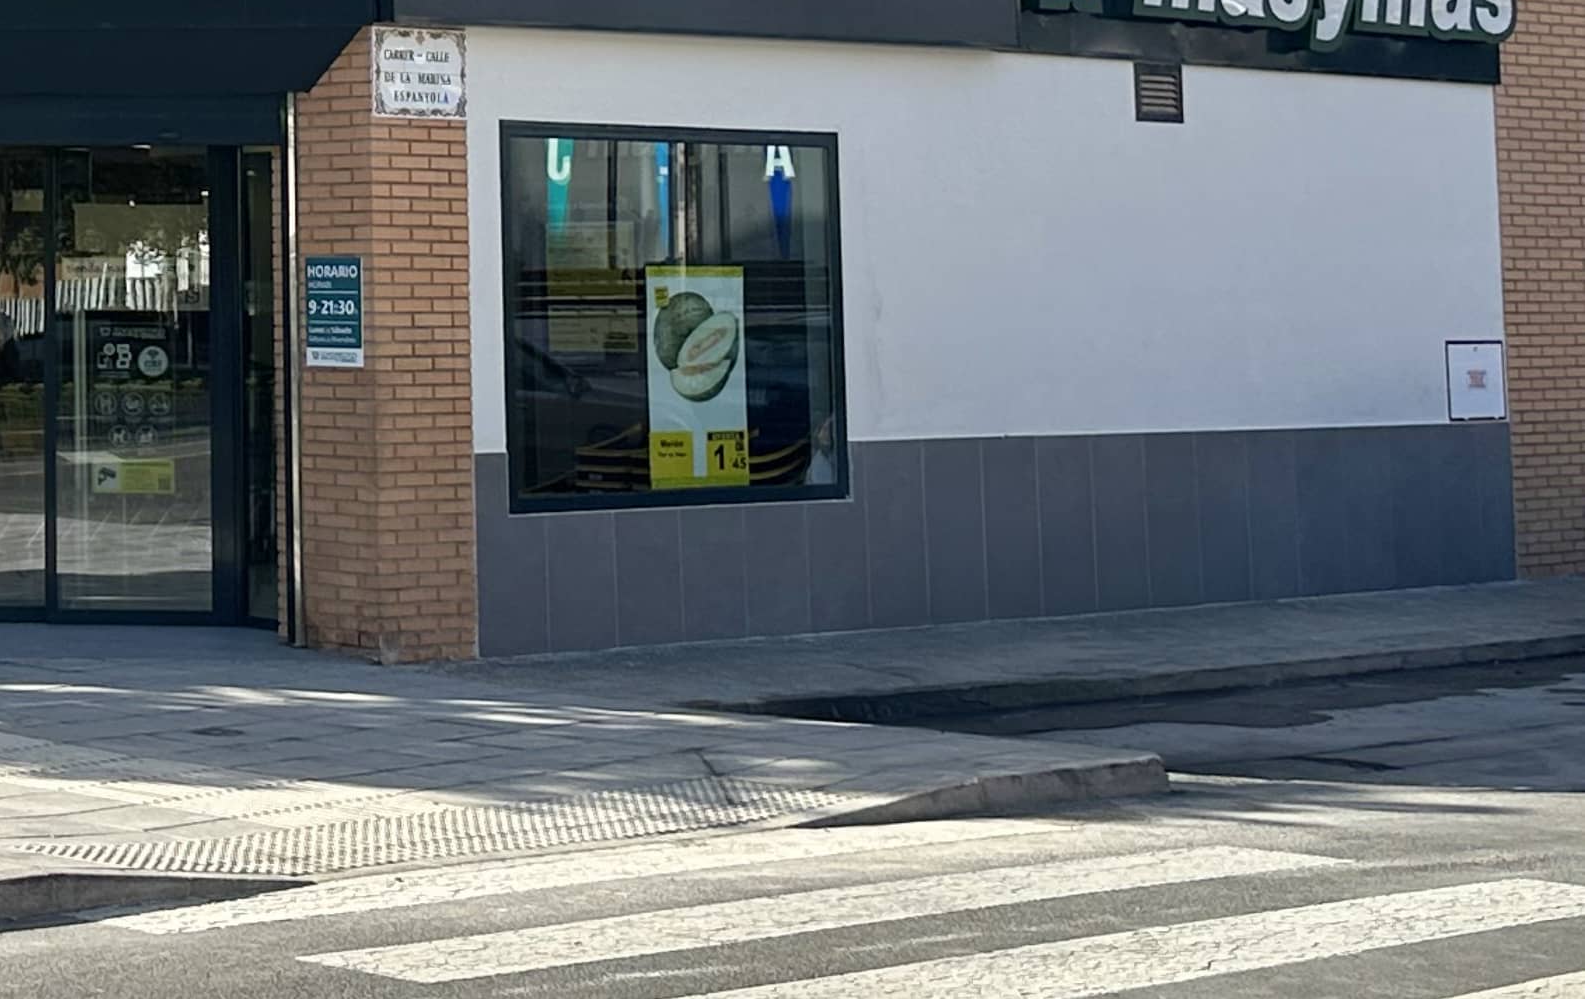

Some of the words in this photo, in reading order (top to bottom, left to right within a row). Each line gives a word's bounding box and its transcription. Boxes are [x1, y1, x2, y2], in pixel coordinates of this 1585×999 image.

[384, 49, 415, 61] CARRER
[426, 51, 450, 62] CALLE
[384, 72, 395, 82] DE
[400, 72, 411, 84] LA
[418, 73, 451, 85] MARINA
[394, 90, 449, 104] ESPANYOLA
[307, 265, 358, 278] HORARIO
